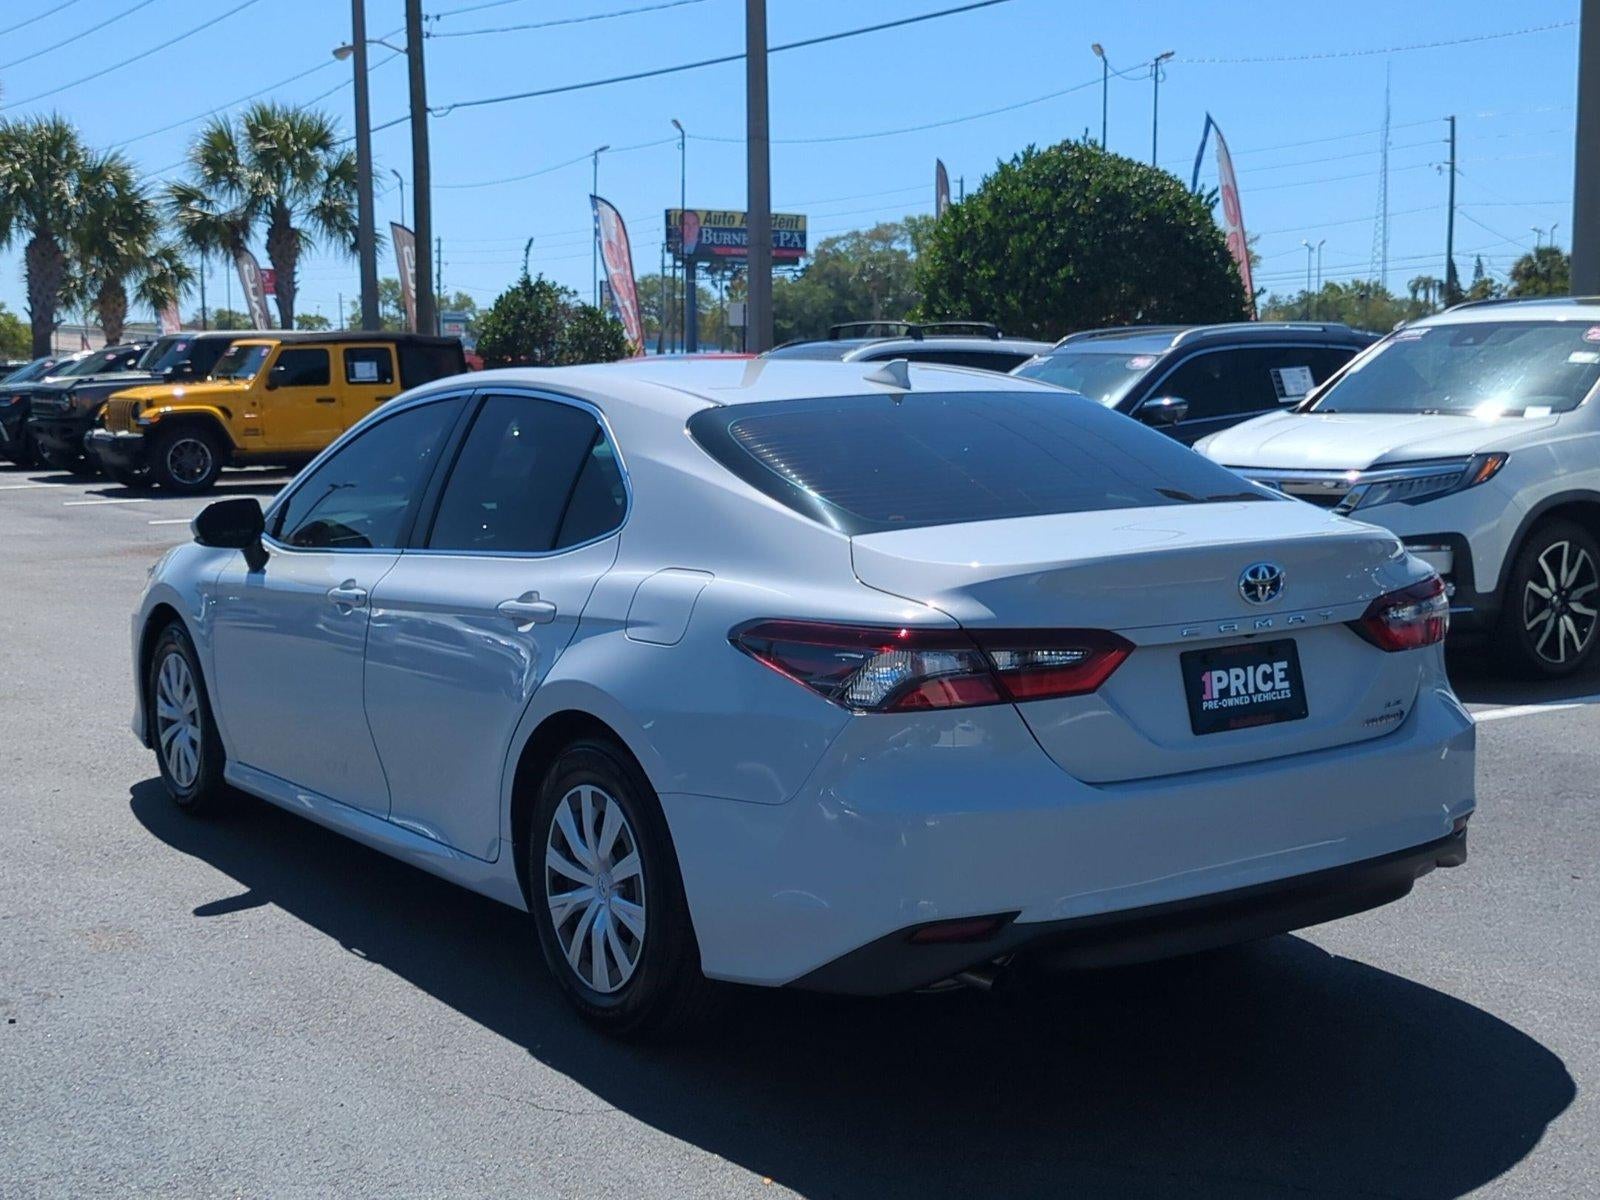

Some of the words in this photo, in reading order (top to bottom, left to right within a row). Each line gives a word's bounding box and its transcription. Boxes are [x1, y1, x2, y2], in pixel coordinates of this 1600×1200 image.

[703, 211, 736, 225] Auto
[738, 213, 798, 229] Adent
[1202, 695, 1250, 711] PRE-OWNED
[1251, 689, 1292, 704] VEHICLES
